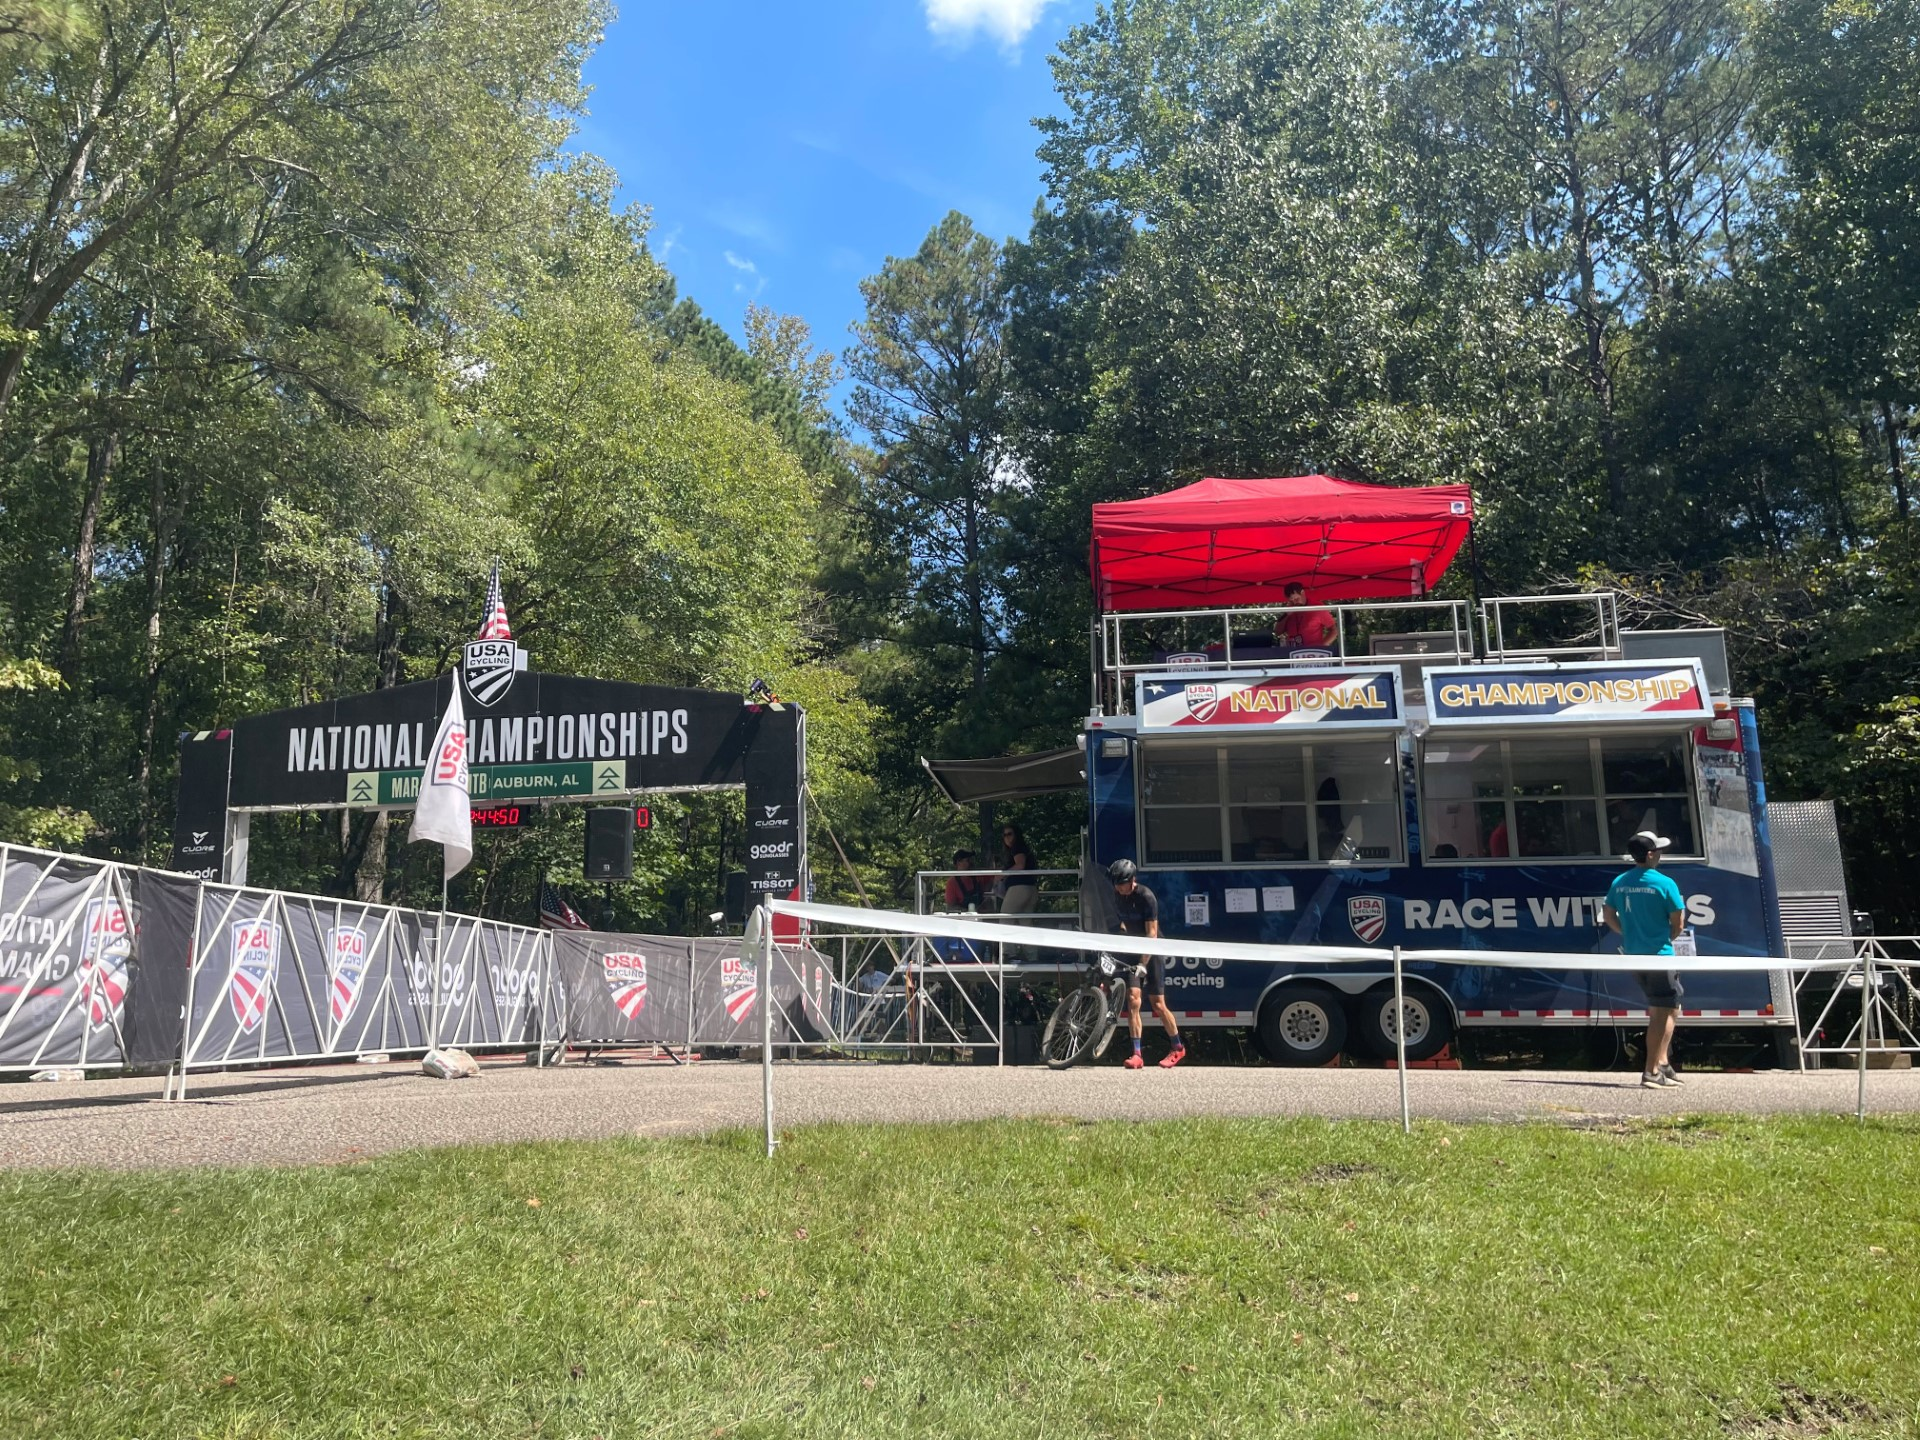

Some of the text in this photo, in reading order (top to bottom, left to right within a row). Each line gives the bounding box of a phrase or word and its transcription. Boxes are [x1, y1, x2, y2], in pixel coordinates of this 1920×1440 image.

[471, 644, 510, 658] USA
[469, 656, 510, 666] CYCLING
[1189, 685, 1213, 694] USA
[1440, 679, 1691, 707] CHAMPIONSHIP
[1231, 686, 1387, 712] NATIONAL
[287, 708, 688, 772] NATIONAL HAMPIONSHIPS
[438, 731, 466, 779] USA
[391, 776, 420, 799] MAR
[493, 775, 558, 789] AUBURN,
[561, 774, 579, 786] AL
[754, 819, 790, 827] CUORE
[182, 845, 216, 853] CUORE
[750, 841, 793, 860] goodr
[750, 879, 794, 889] TISSOT
[1353, 900, 1381, 909] USA
[1404, 898, 1518, 929] RACE
[1526, 896, 1605, 928] WIT
[606, 954, 644, 971] USA
[606, 969, 645, 980] CYCLING
[723, 974, 755, 983] CYCLING
[1164, 973, 1225, 989] acycling
